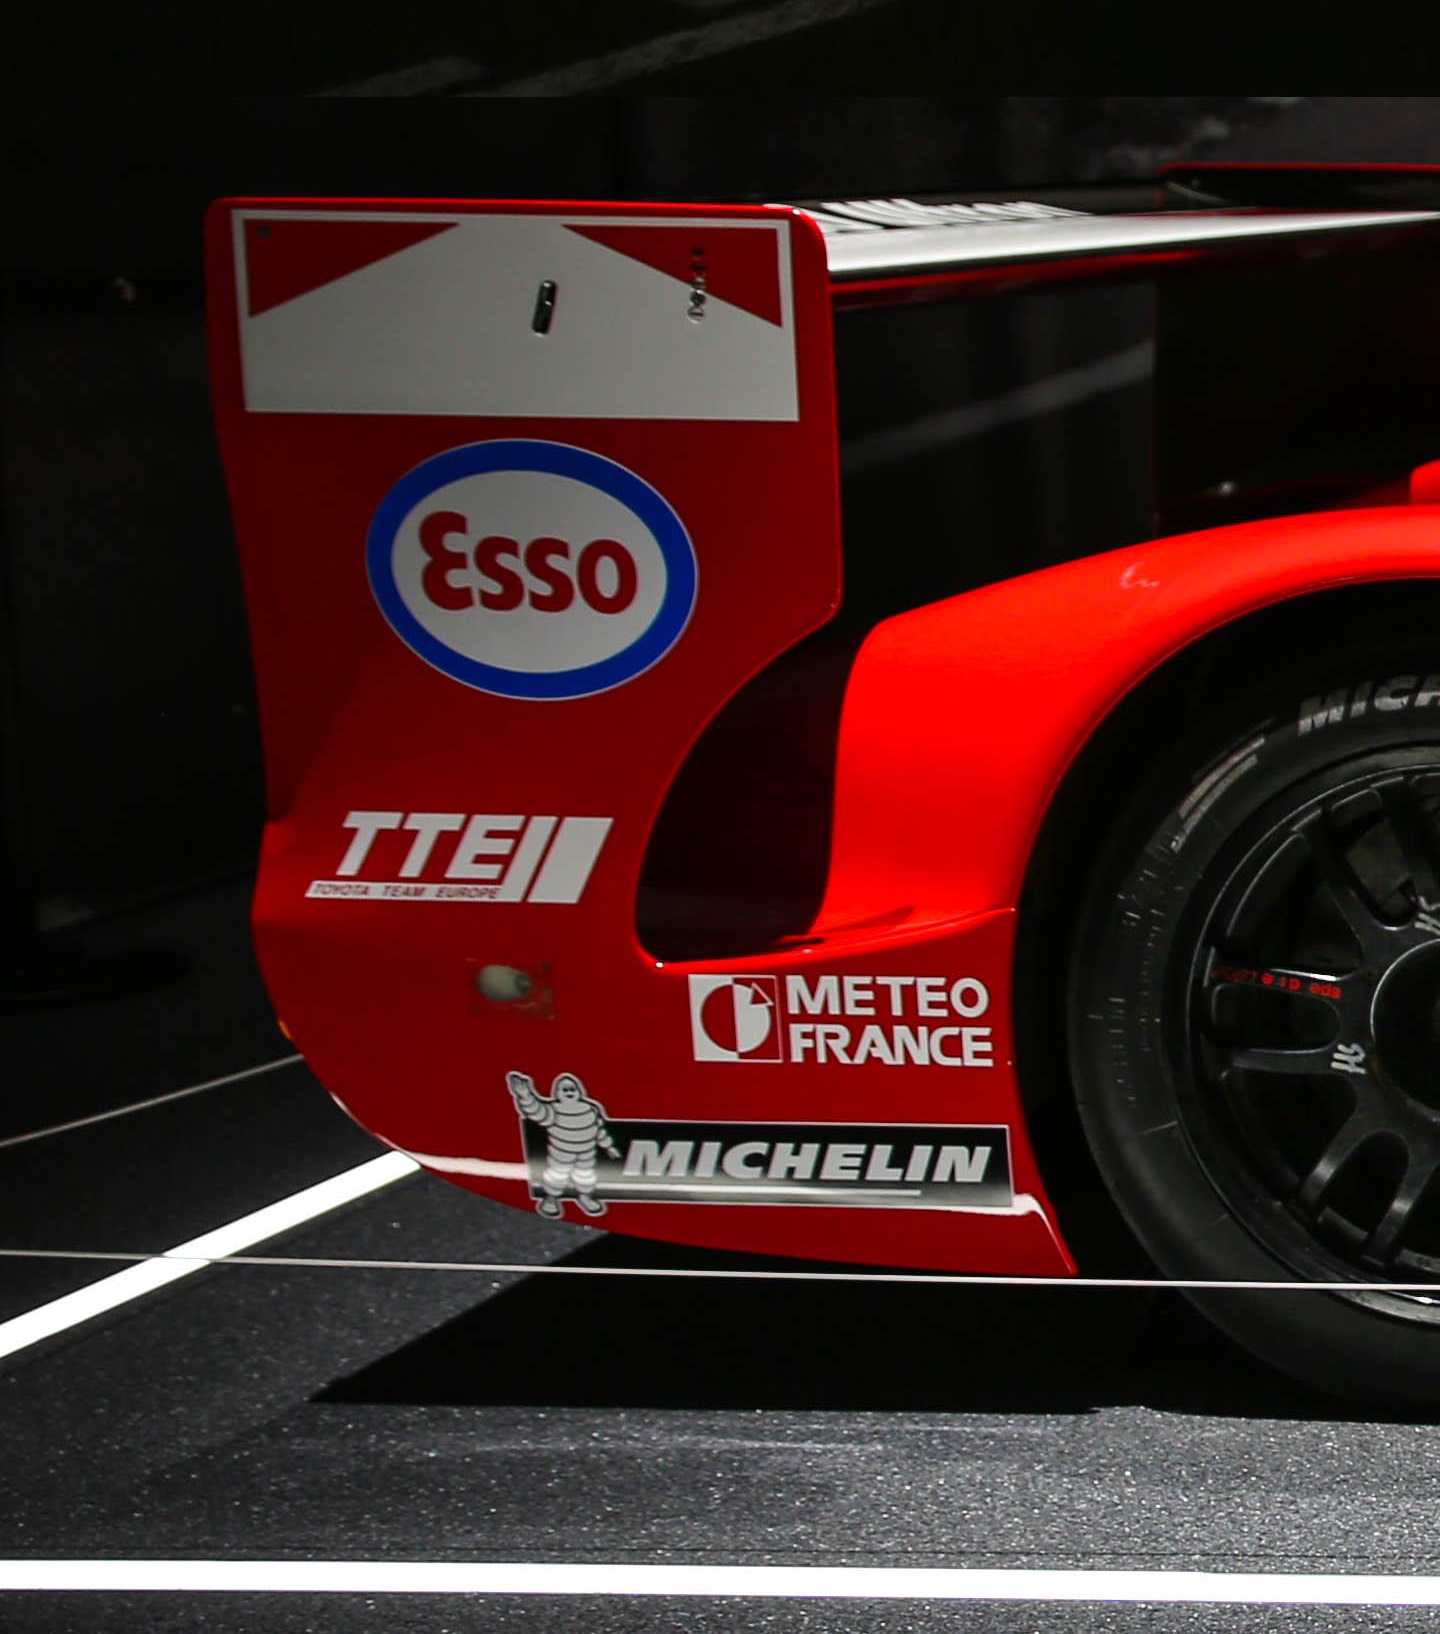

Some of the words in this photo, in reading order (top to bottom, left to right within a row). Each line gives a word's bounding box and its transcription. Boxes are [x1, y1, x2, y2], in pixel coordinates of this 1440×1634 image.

[417, 511, 638, 616] Esso
[336, 810, 525, 880] TTE
[314, 883, 370, 897] TOYOTA
[382, 884, 427, 898] TEAM
[435, 885, 501, 899] EUROPE
[786, 974, 989, 1018] METEO
[789, 1023, 994, 1067] FRANCE
[622, 1138, 994, 1183] MICHELIN
